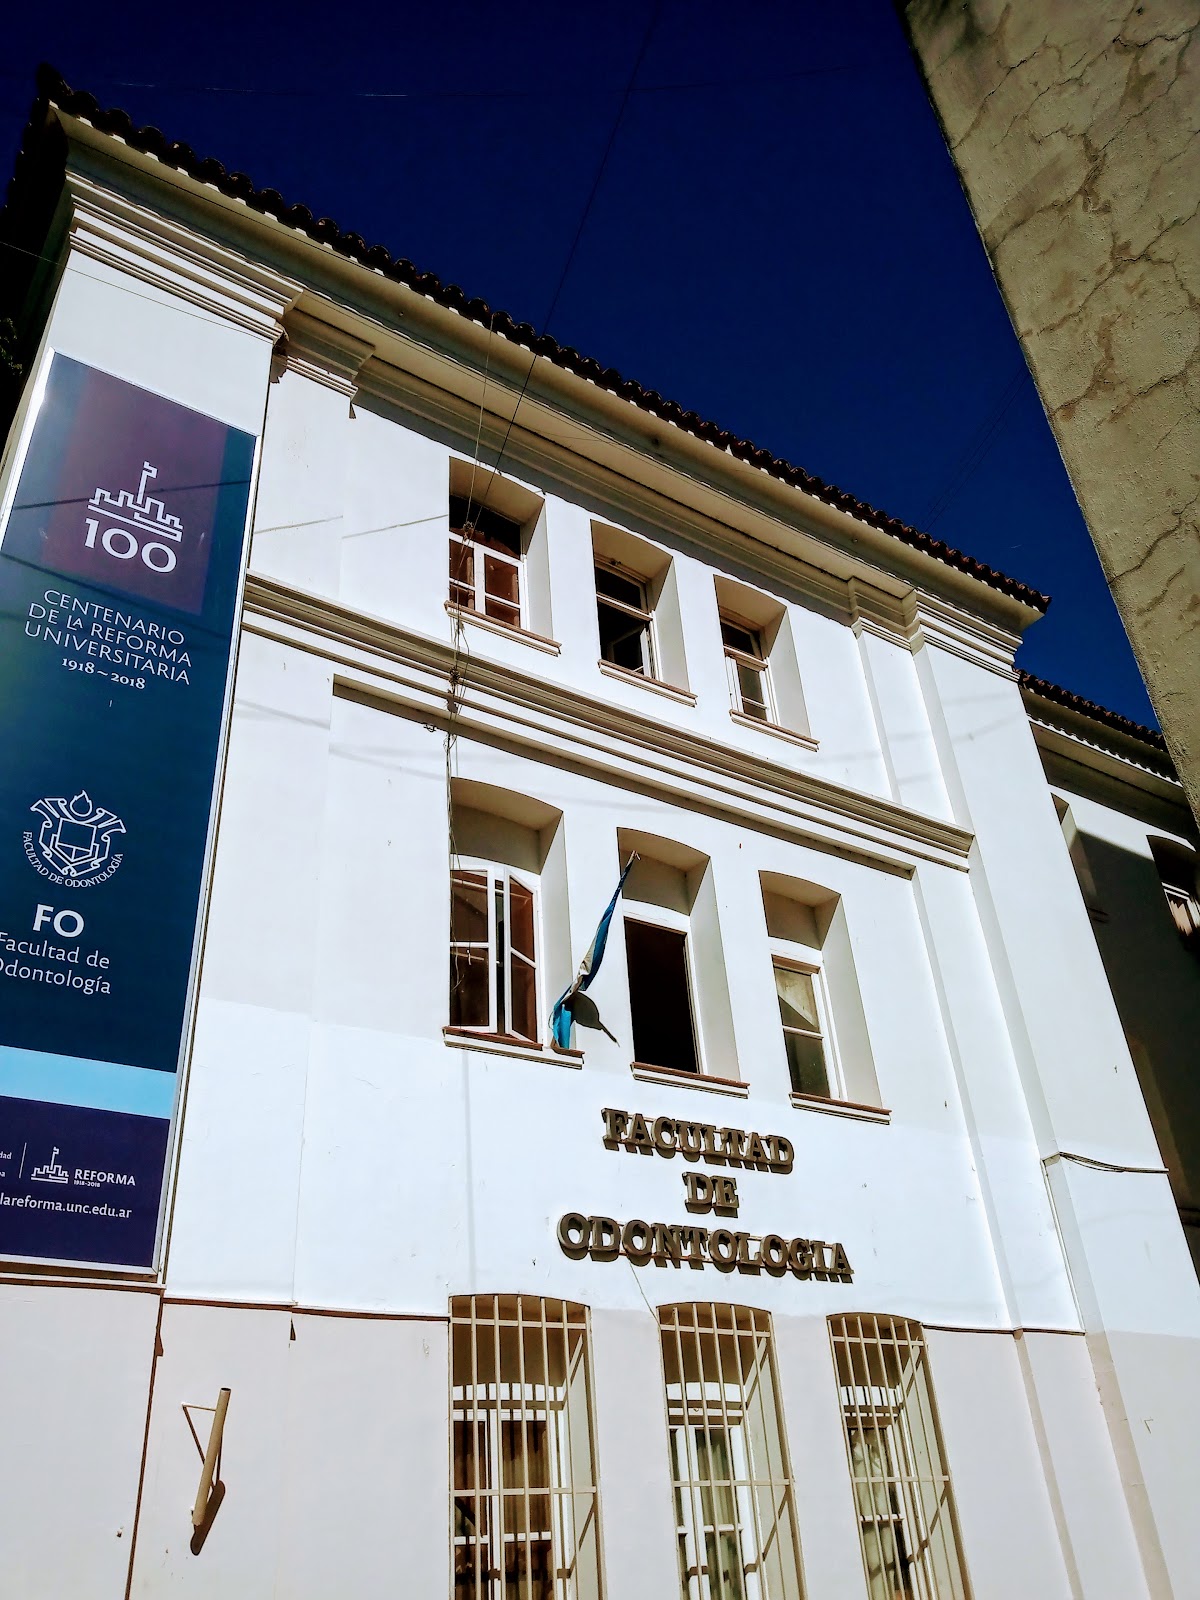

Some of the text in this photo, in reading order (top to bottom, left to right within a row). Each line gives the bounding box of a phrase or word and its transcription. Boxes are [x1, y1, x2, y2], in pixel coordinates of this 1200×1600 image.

[84, 517, 177, 573] 100
[28, 602, 192, 668] DE LA REFORMA
[44, 589, 185, 646] CENTENARIO
[24, 620, 190, 686] UNIVERSITARIA
[23, 831, 124, 888] FACULTAD DE ODONTOLOGÍA
[32, 903, 85, 938] FO
[86, 949, 110, 969] de
[601, 1107, 795, 1168] FACULTAD
[0, 1192, 133, 1219] lareforma.unc.edu.ar
[74, 1168, 136, 1187] REFORMA
[682, 1171, 739, 1212] DE
[556, 1212, 854, 1280] ODONTOLOGIA
